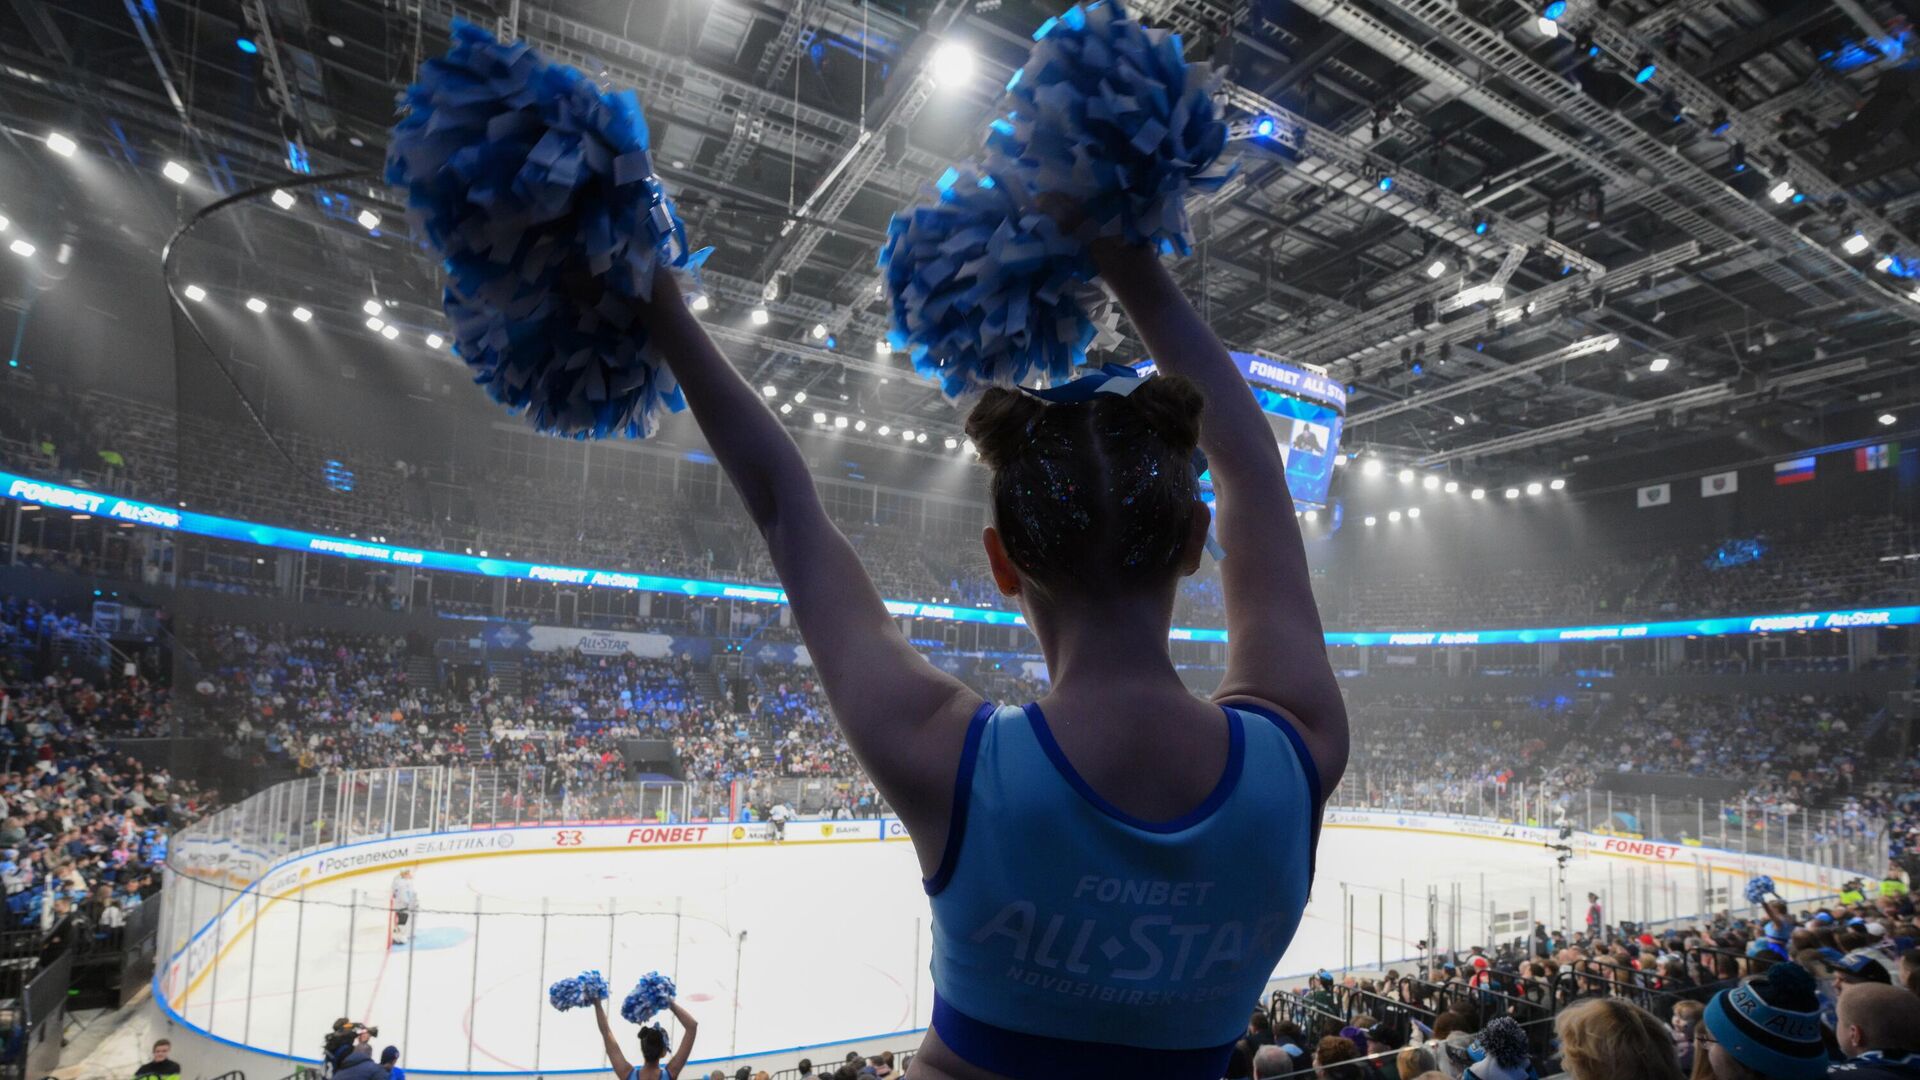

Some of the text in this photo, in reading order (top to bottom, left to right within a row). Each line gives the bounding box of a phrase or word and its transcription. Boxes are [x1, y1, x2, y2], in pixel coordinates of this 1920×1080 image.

[1249, 360, 1300, 387] FONBET
[1303, 376, 1326, 395] ALL
[9, 480, 105, 512] FONBET
[1750, 615, 1819, 631] FONBET
[627, 827, 709, 844] FONBET
[325, 847, 409, 873] Ростелеком
[1604, 839, 1680, 860] FONBET
[1072, 874, 1217, 907] FONBET
[1736, 991, 1757, 1014] AR
